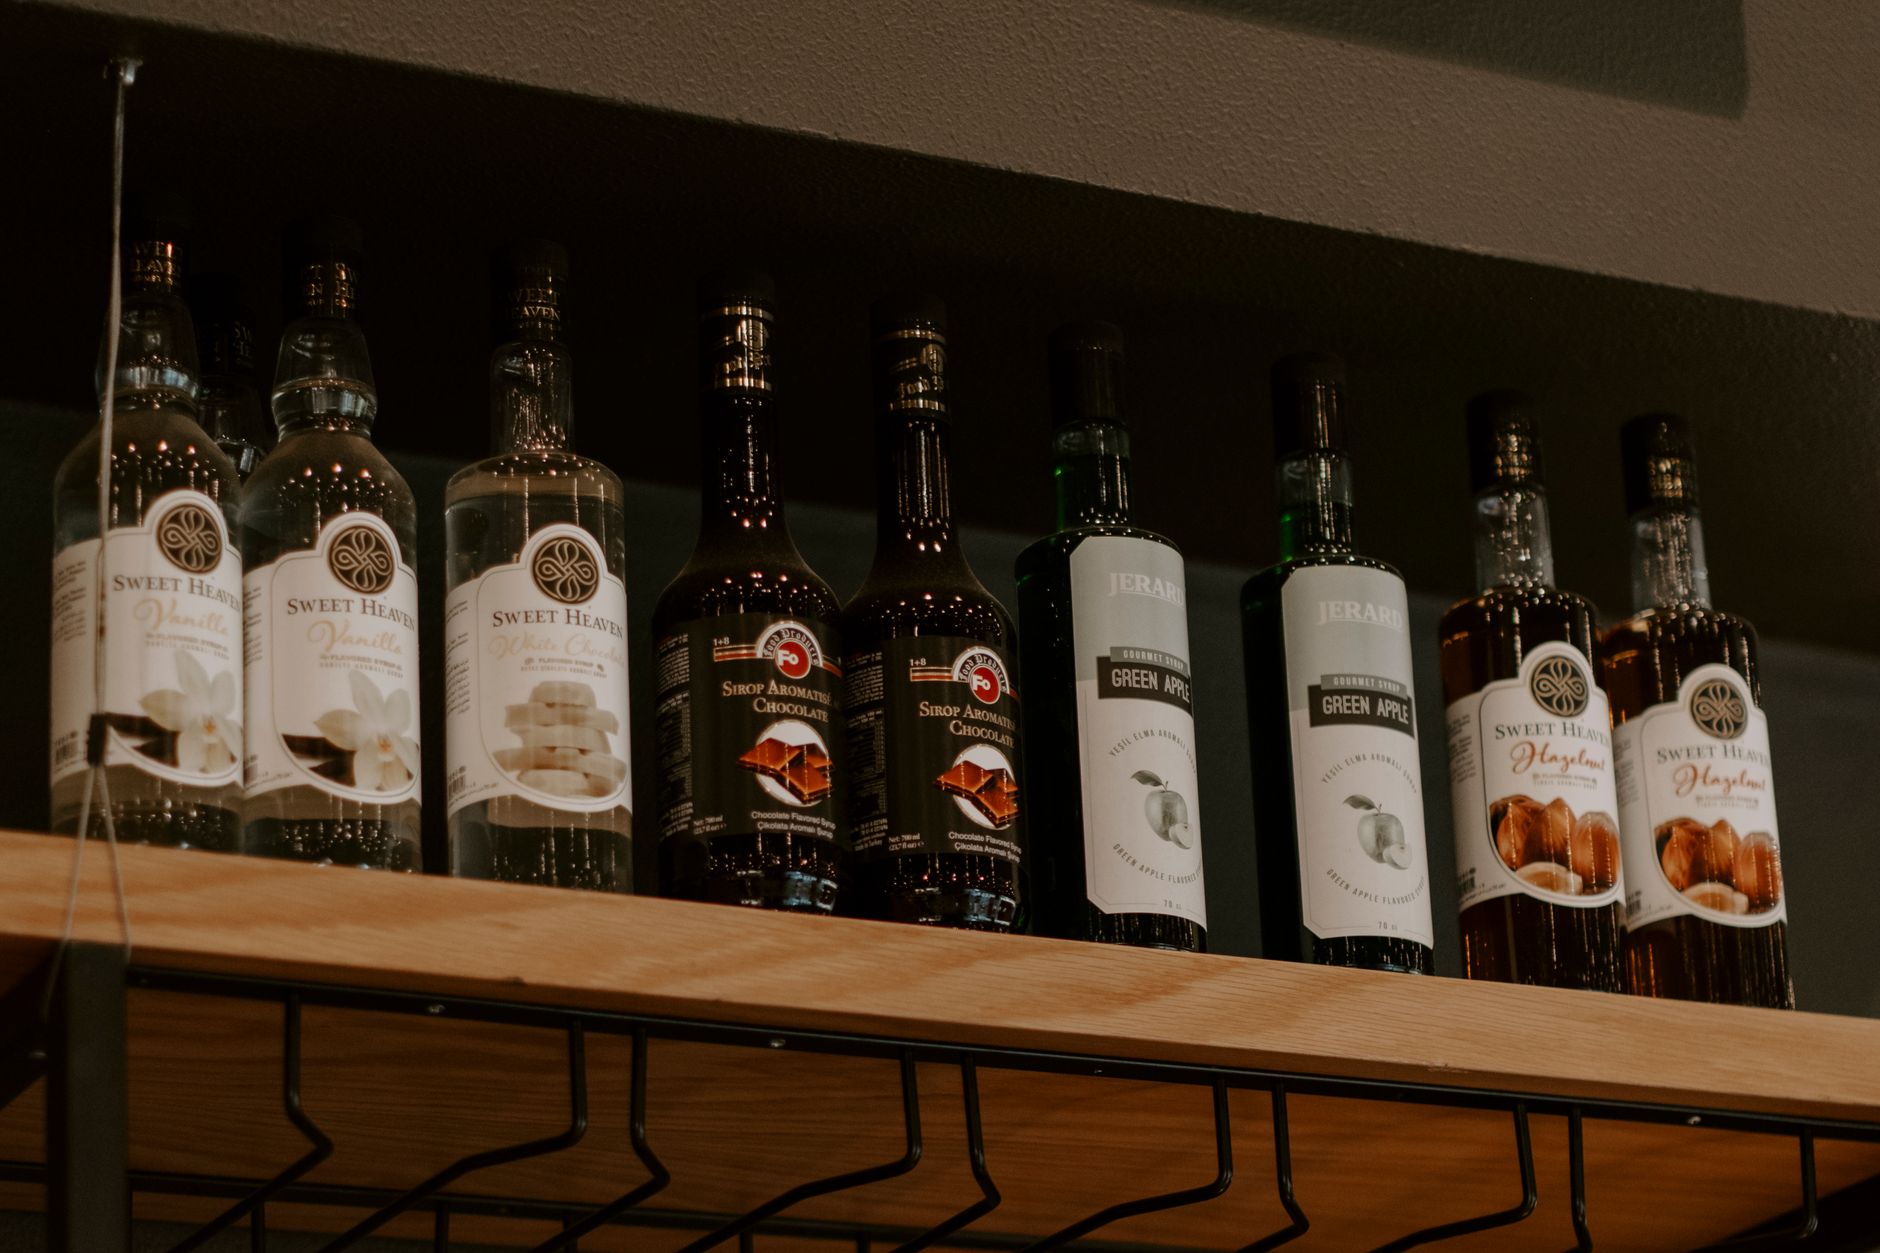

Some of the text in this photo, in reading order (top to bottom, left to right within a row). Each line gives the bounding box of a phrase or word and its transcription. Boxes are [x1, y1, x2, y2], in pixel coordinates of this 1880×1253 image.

[510, 306, 561, 321] EAVEN
[113, 574, 182, 592] SWEET
[133, 597, 230, 637] Vanilla
[287, 596, 416, 633] SWEET HEAVEN
[492, 607, 623, 640] SWEET HEAVEN
[1317, 600, 1404, 630] JERARD
[305, 618, 403, 655] Vanilla
[713, 636, 730, 646] 1+8
[910, 657, 927, 667] 1+8
[1122, 648, 1163, 663] GOURMET
[722, 680, 766, 697] SIROP
[1111, 667, 1191, 704] GREEN APPLE
[752, 696, 830, 723] CHOCOLATE
[920, 700, 961, 718] SIROP
[1322, 695, 1409, 725] GREEN APPLE
[1495, 722, 1556, 741] SWEET
[1510, 741, 1606, 775] Hazelnut
[1656, 743, 1716, 765] SWEET
[1672, 762, 1766, 799] Hazelnut
[751, 810, 790, 821] Chocolate
[948, 831, 985, 842] Chocolate
[1138, 863, 1166, 882] APPLE
[1326, 868, 1350, 892] GREEN
[1351, 887, 1379, 904] APPLE
